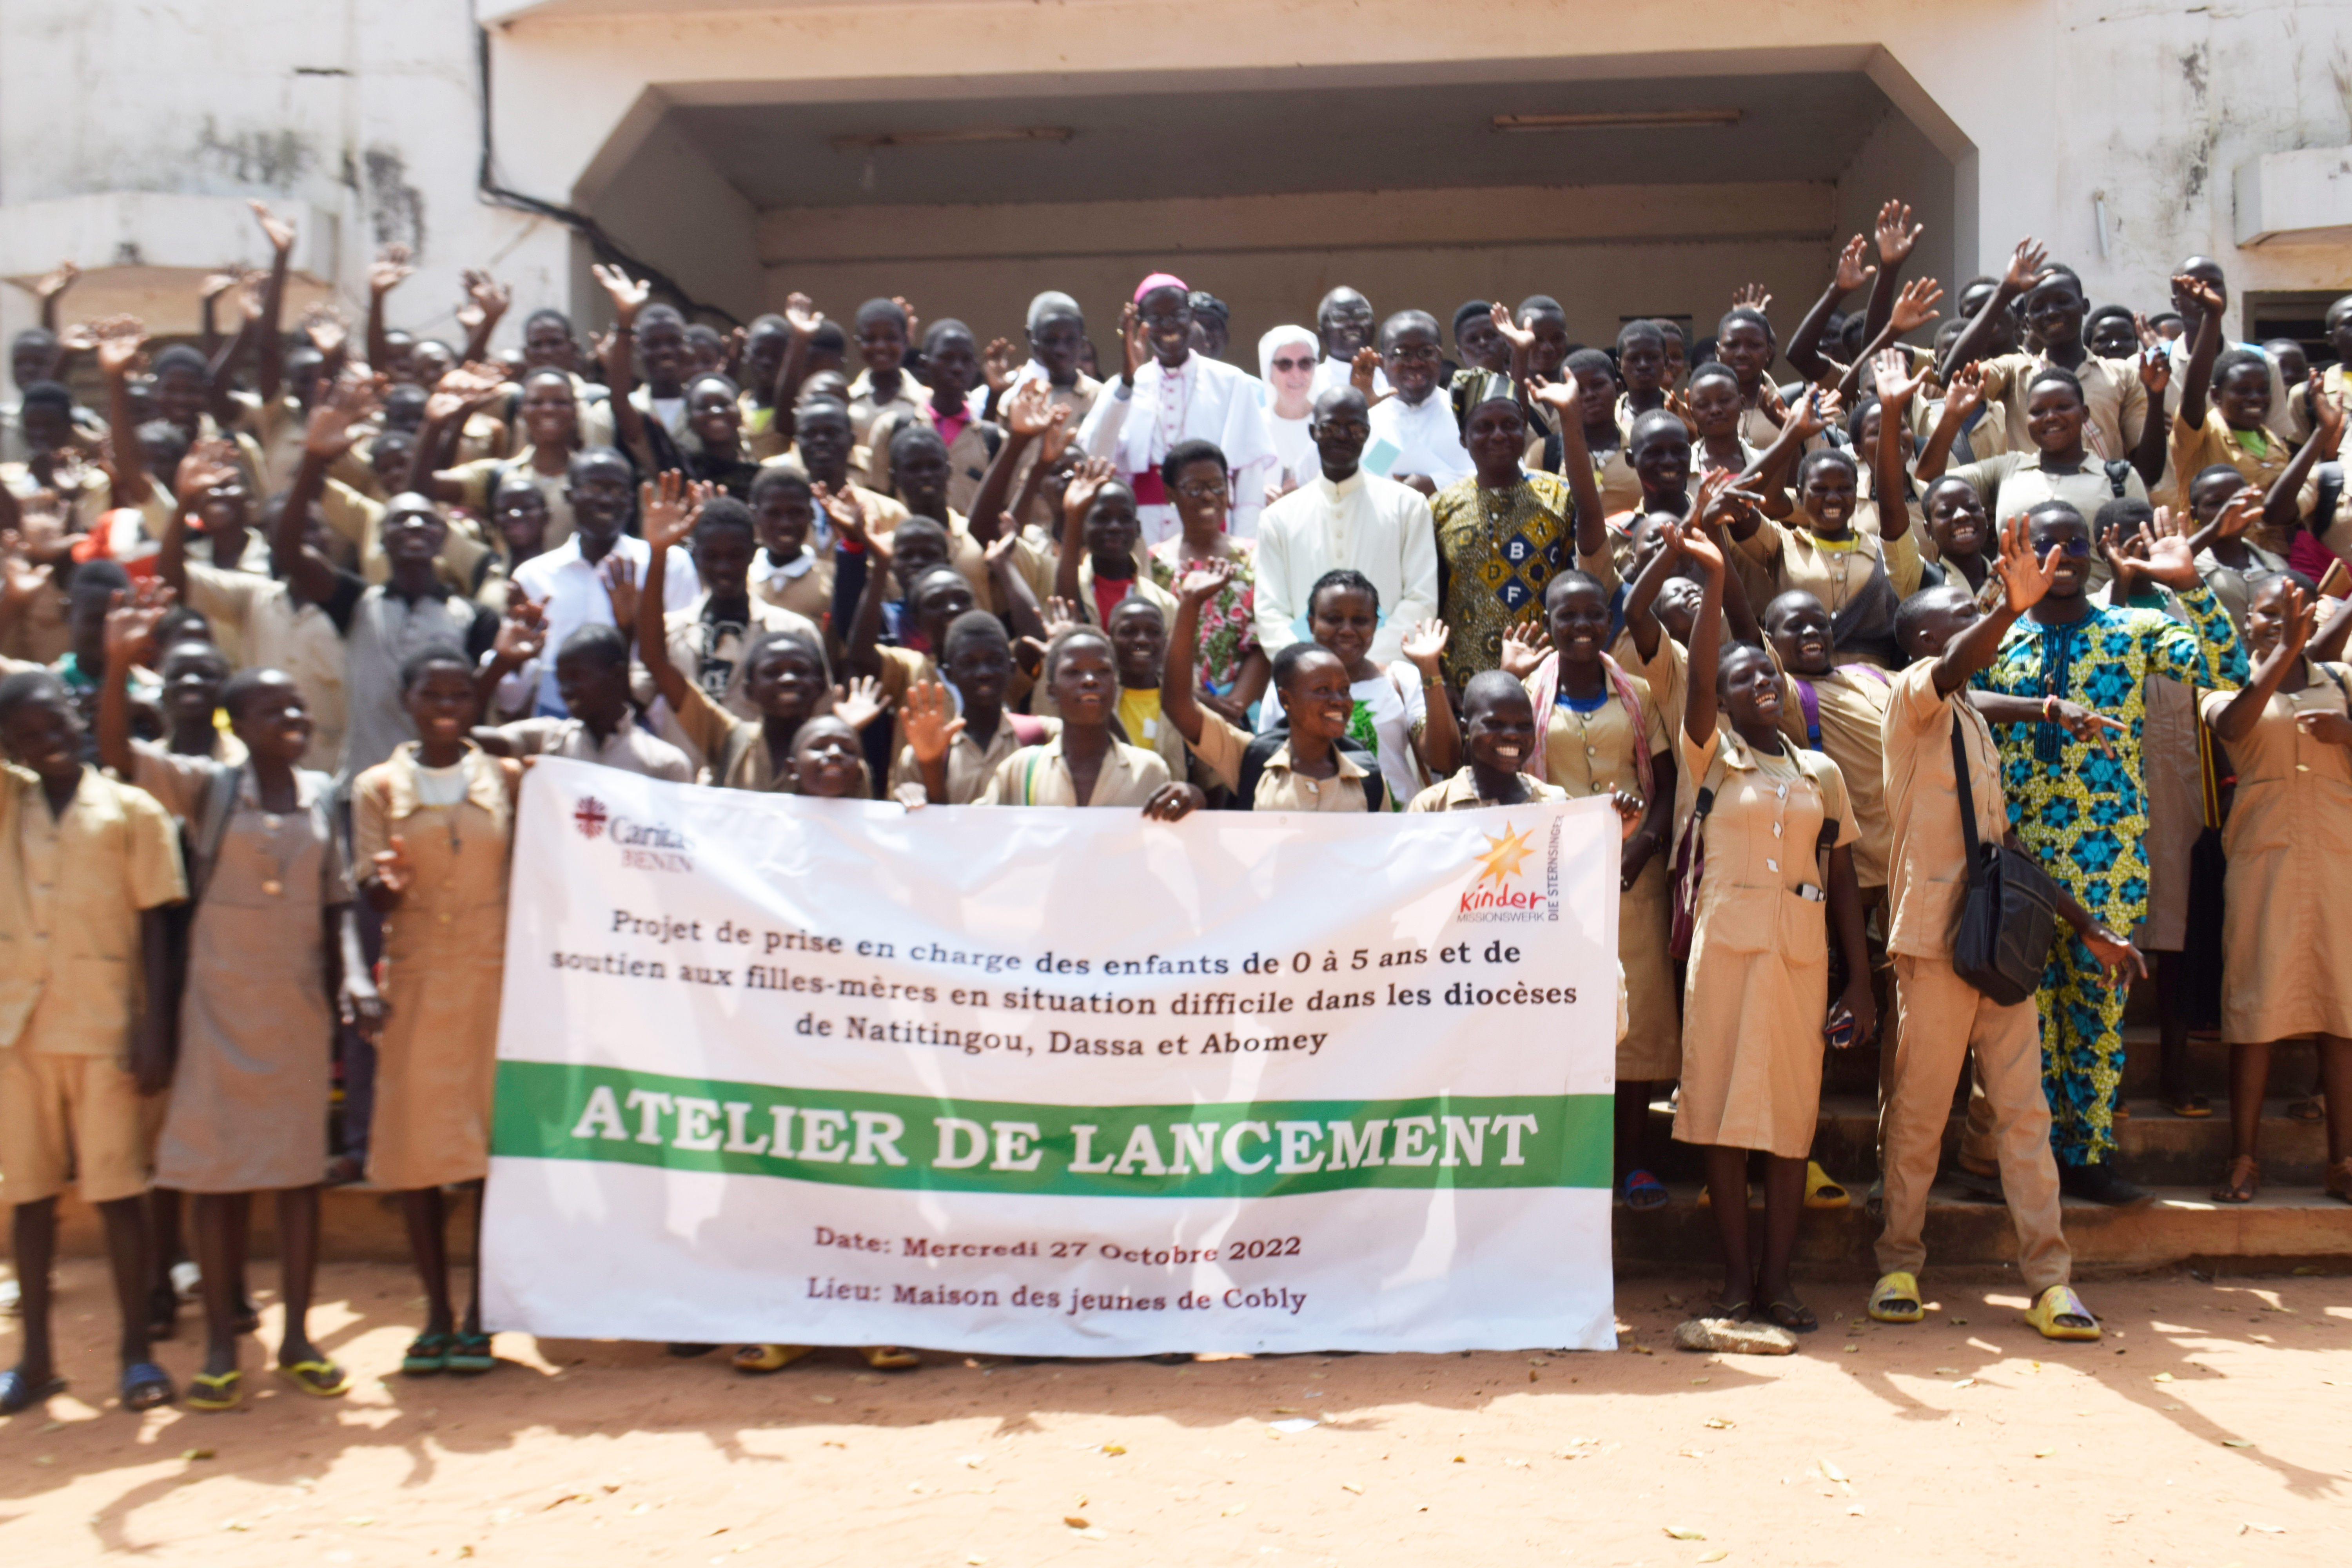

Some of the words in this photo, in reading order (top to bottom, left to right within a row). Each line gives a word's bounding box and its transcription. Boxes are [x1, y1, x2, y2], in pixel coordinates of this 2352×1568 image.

[1510, 542, 1524, 559] B
[1507, 586, 1521, 603] F
[1547, 814, 1564, 897] STERNSINGER
[1456, 910, 1545, 923] MISSIONSWERK
[1460, 883, 1546, 913] kinder
[1548, 900, 1559, 921] DIE
[611, 909, 702, 944] Projet
[715, 920, 752, 945] de
[764, 929, 843, 956] prise
[856, 940, 895, 958] en
[909, 942, 1022, 974] charge
[1035, 950, 1091, 975] des
[1103, 953, 1229, 976] enfants
[1242, 951, 1280, 975] de
[1292, 951, 1312, 974] 0
[1321, 949, 1338, 973] à
[1350, 948, 1369, 971] 5
[1378, 948, 1428, 968] ans
[1439, 941, 1472, 964] et
[1483, 939, 1521, 964] de
[550, 948, 666, 979] soutien
[679, 964, 733, 987] aux
[745, 964, 938, 1004] filles-mères
[949, 988, 990, 1008] en
[1002, 985, 1157, 1016] situation
[1170, 990, 1294, 1016] difficile
[1306, 988, 1376, 1012] dans
[1387, 982, 1432, 1007] les
[1444, 980, 1577, 1006] diocèses
[795, 1011, 833, 1037] de
[845, 1016, 1034, 1058] Natitingou,
[1047, 1030, 1144, 1056] Dassa
[1156, 1034, 1189, 1056] et
[1200, 1031, 1329, 1056] Abomey
[572, 1086, 909, 1166] ATELIER
[932, 1116, 1044, 1172] DE
[1067, 1114, 1539, 1176] LANCEMENT
[814, 1226, 891, 1254] Date:
[902, 1236, 1039, 1258] Mercredi
[1050, 1241, 1090, 1259] 27
[1098, 1242, 1220, 1269] Octobre
[1227, 1235, 1301, 1262] 2022
[806, 1276, 880, 1302] Lieu:
[893, 1283, 1000, 1307] Maison
[1010, 1284, 1061, 1308] des
[1065, 1287, 1167, 1317] jeunes
[1177, 1290, 1211, 1311] de
[1222, 1286, 1308, 1316] Cobly
